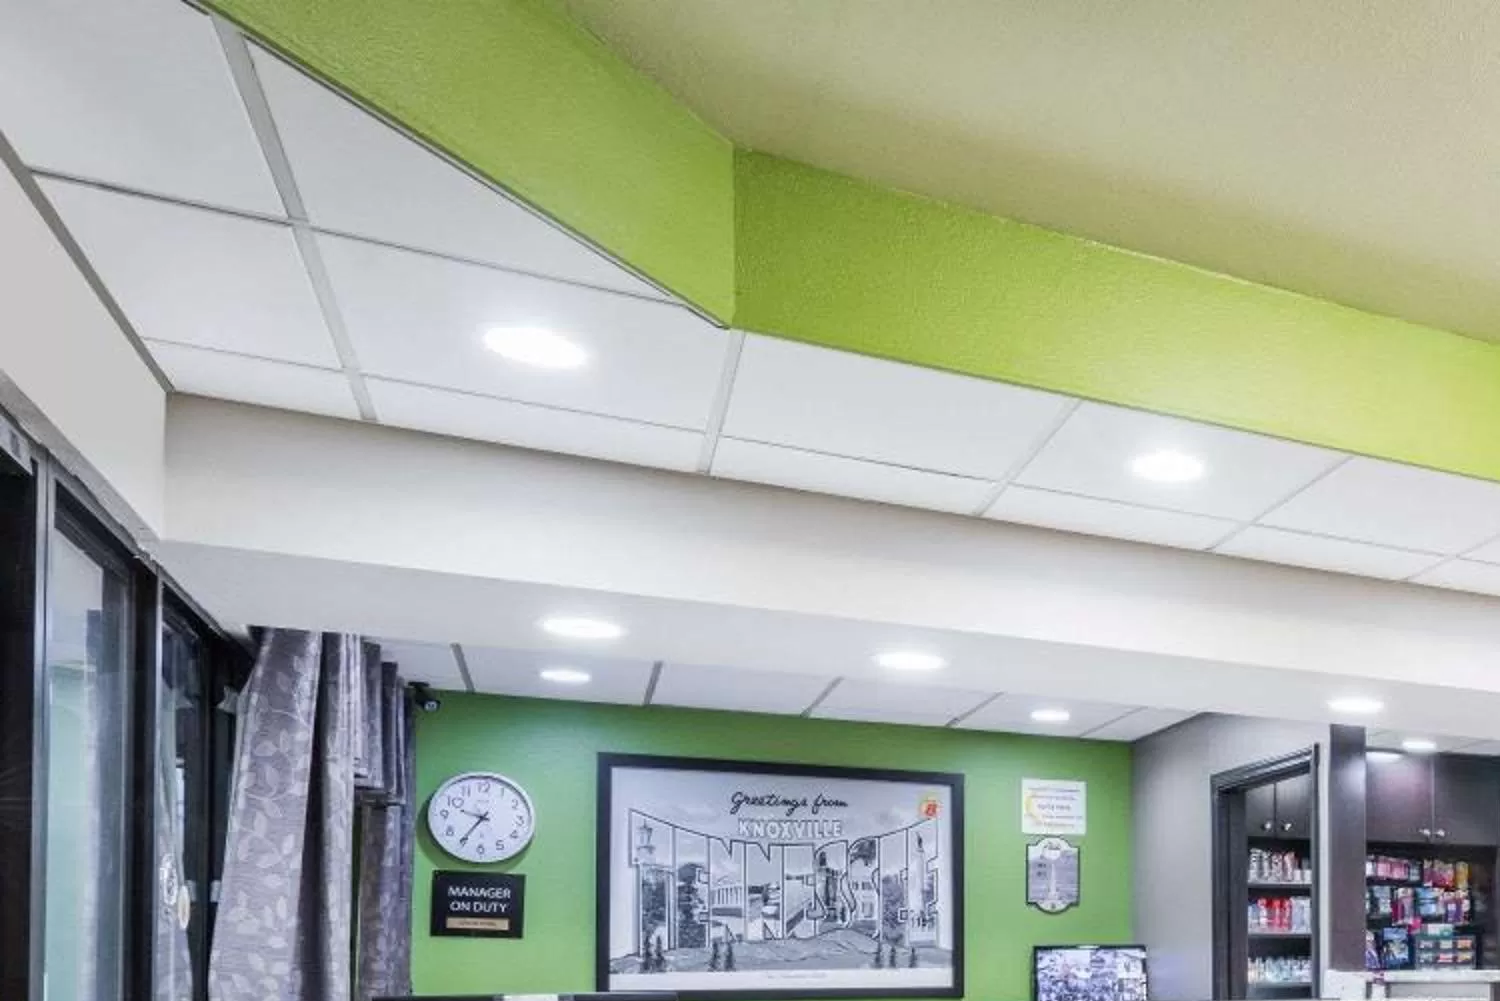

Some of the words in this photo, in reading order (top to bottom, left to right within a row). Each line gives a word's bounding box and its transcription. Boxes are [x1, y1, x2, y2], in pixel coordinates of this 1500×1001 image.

[461, 785, 471, 797] 11
[478, 781, 491, 793] 12
[447, 796, 465, 808] 10
[511, 798, 519, 810] 2
[730, 791, 808, 816] Greetings
[811, 793, 849, 815] from
[440, 809, 450, 820] 9
[515, 815, 525, 827] 3
[445, 825, 455, 837] 8
[510, 829, 519, 839] 4
[738, 818, 843, 839] KNOXVILLE
[476, 843, 485, 855] 6
[495, 840, 505, 851] 5
[629, 808, 938, 955] TENNESSEE
[448, 886, 511, 899] MANAGER
[450, 901, 471, 911] ON
[473, 902, 507, 913] DUTY
